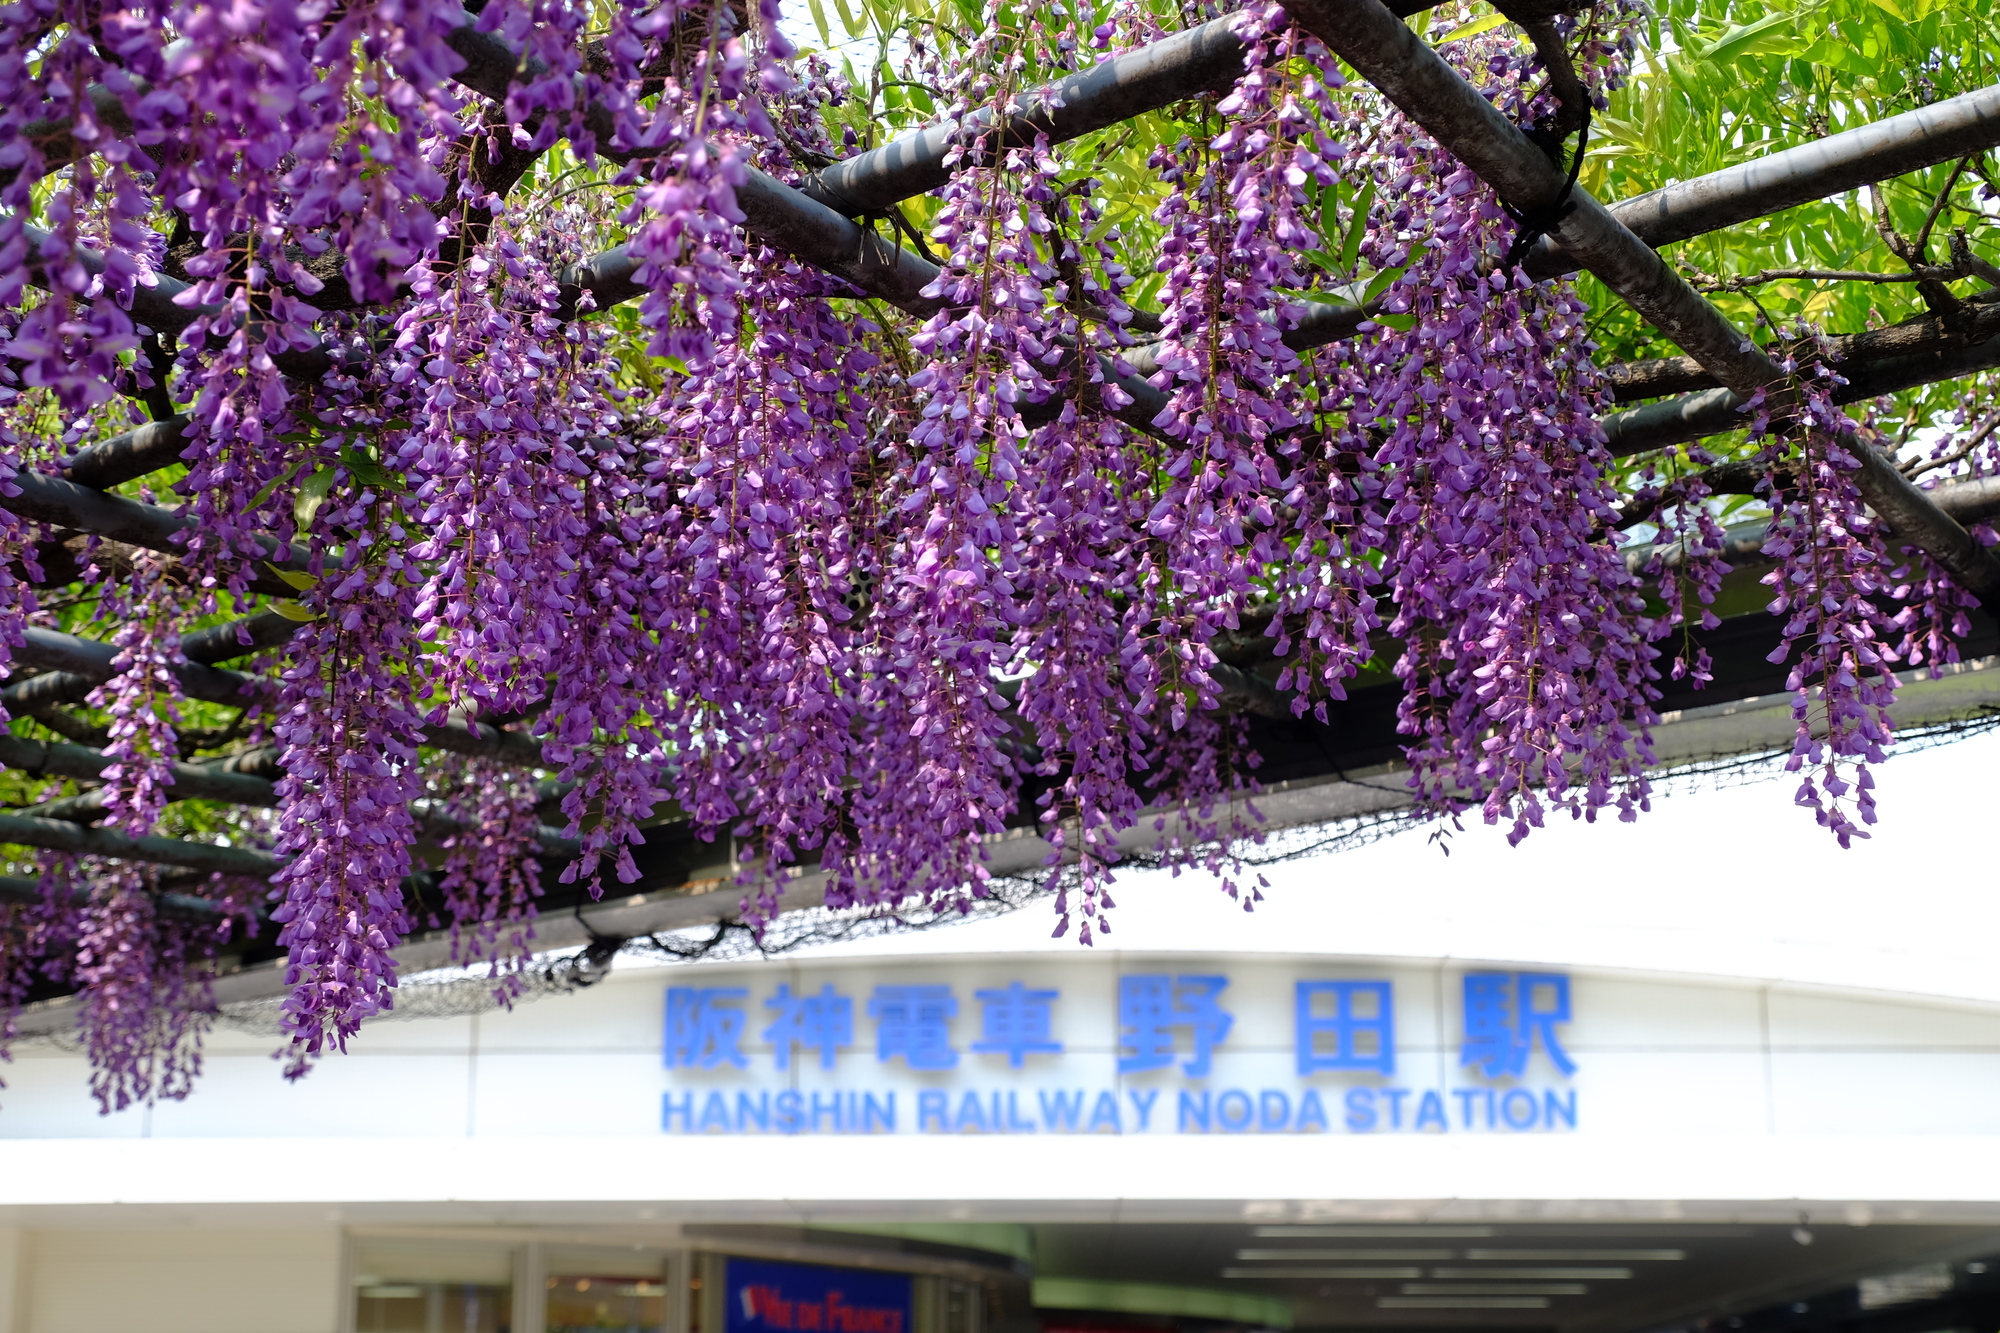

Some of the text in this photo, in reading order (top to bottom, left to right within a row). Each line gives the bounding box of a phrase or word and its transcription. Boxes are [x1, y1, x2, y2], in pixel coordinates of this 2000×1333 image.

[661, 974, 1579, 1079] 阪神電車 野田駅
[661, 1085, 1578, 1134] HANSHIN RAILWAY NODA STATION
